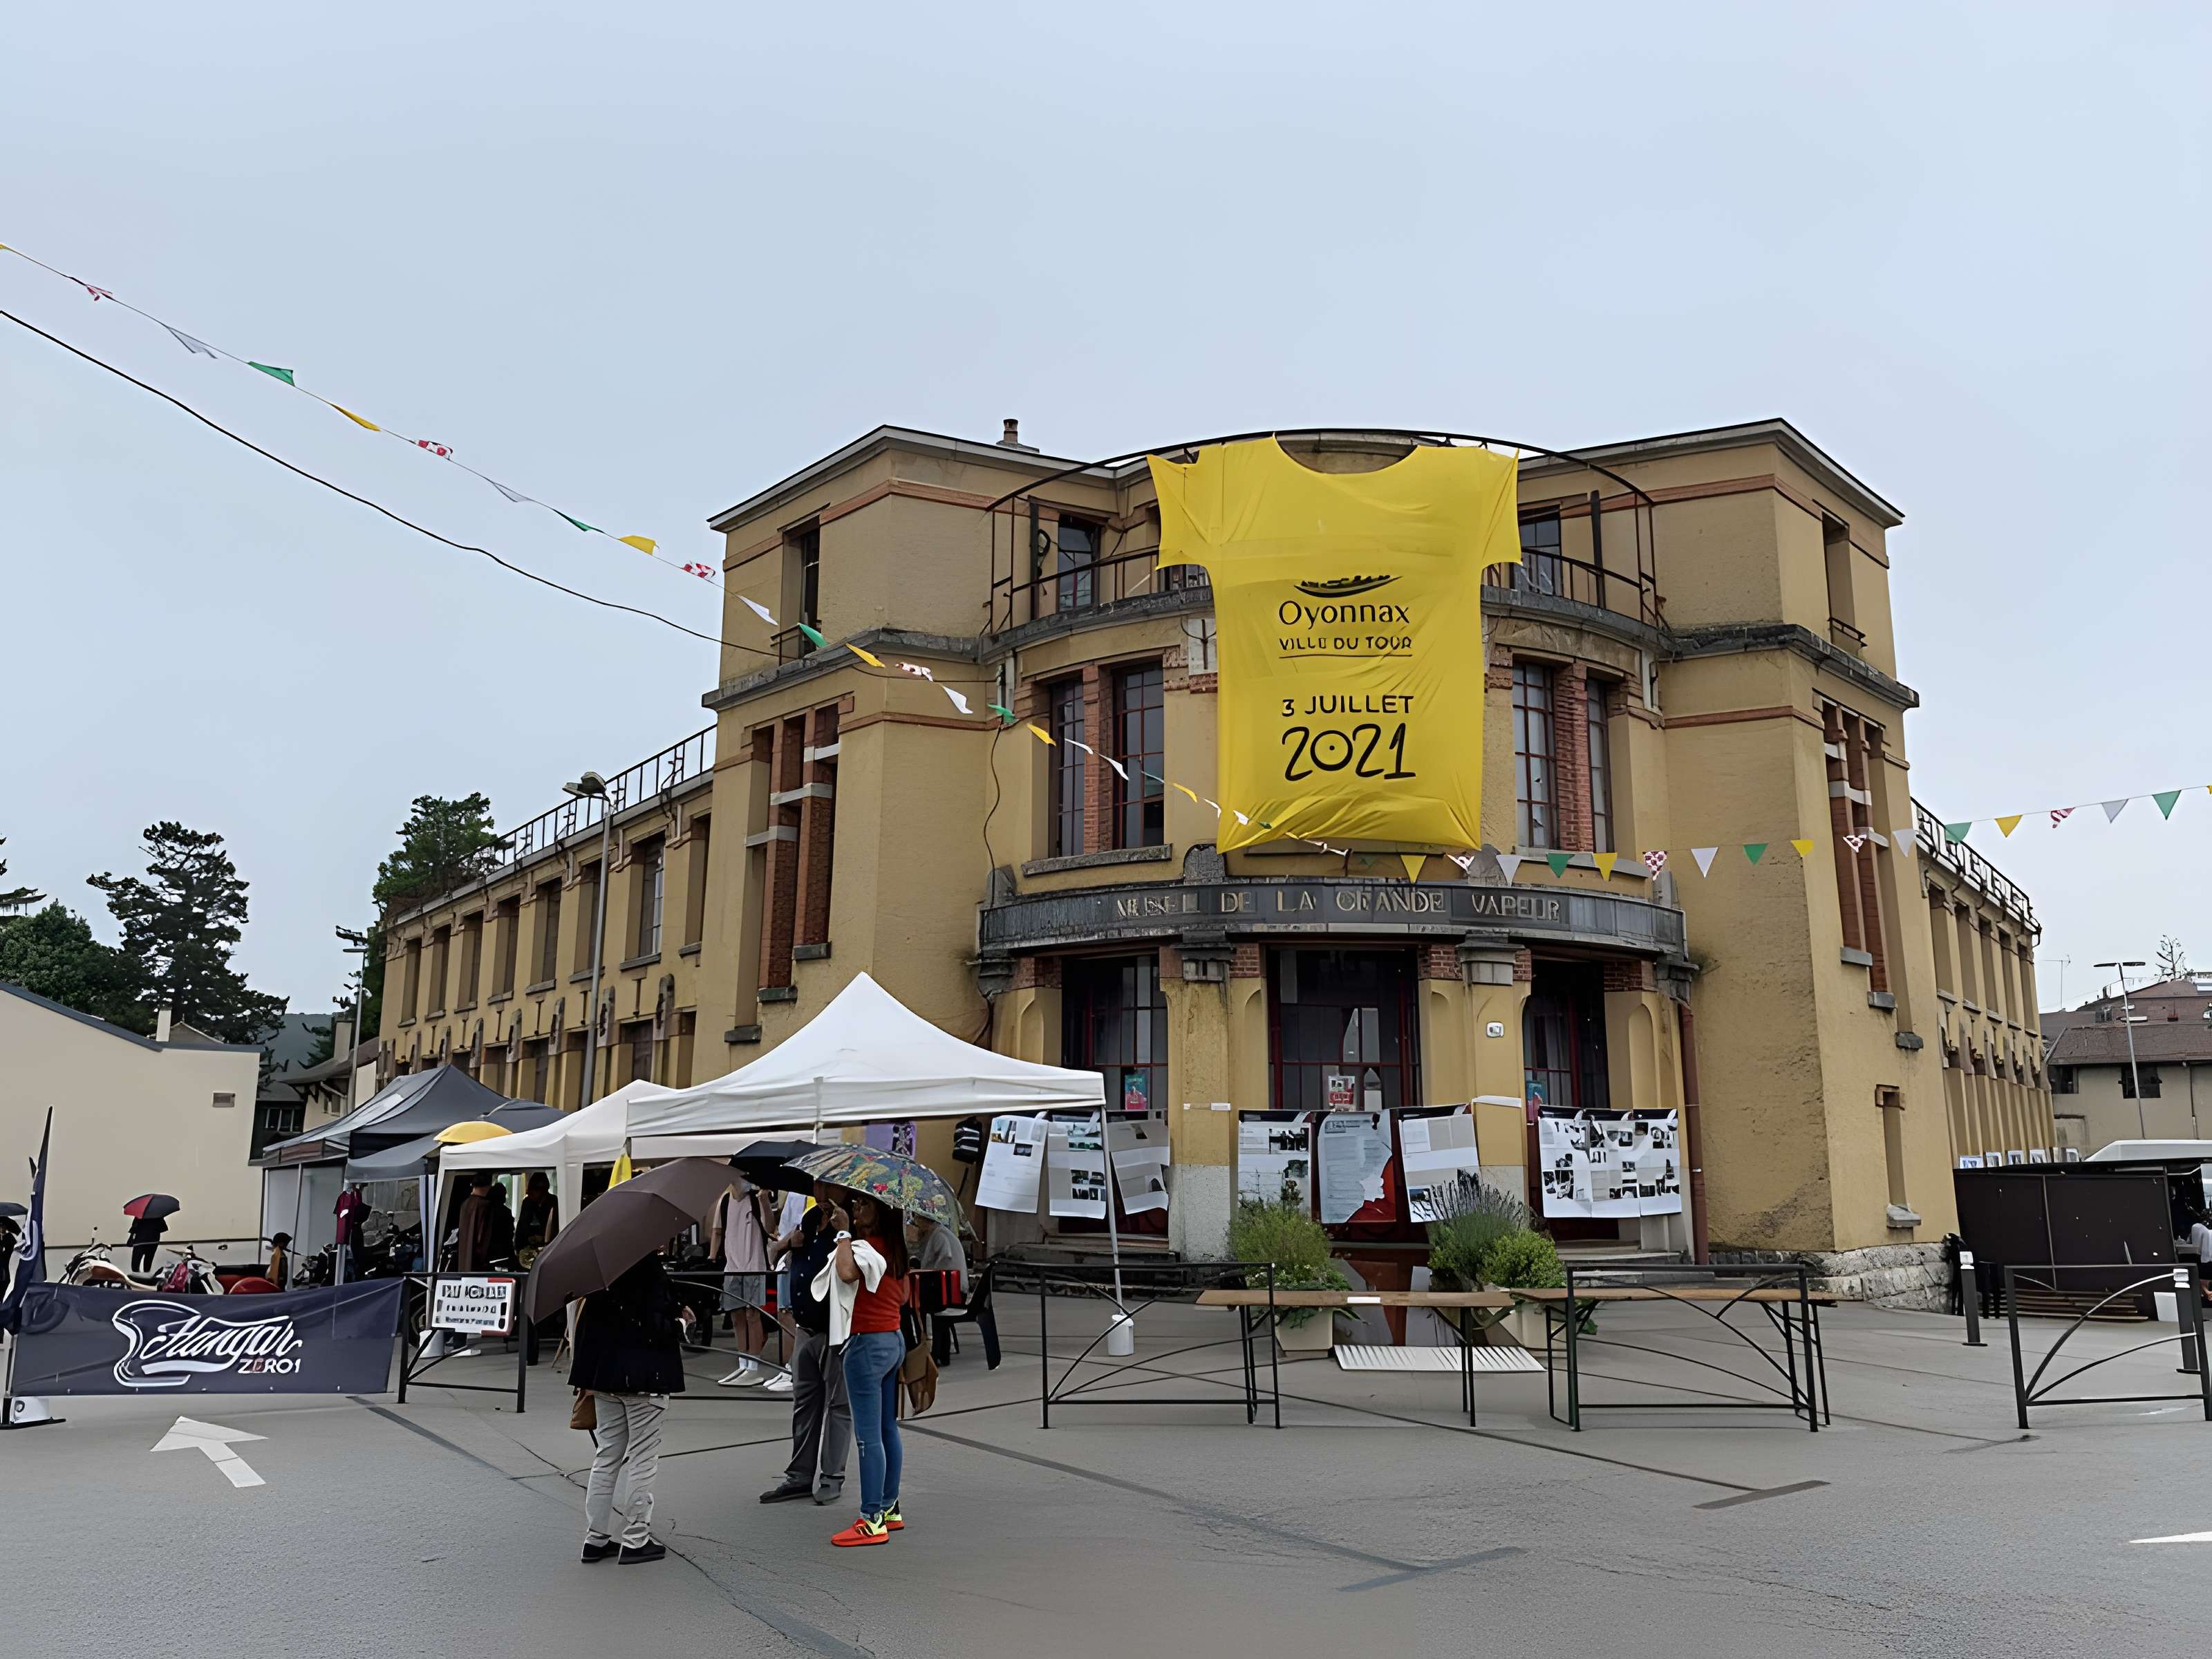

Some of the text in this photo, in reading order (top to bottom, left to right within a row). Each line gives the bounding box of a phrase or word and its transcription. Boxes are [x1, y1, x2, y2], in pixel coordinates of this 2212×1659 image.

[1279, 600, 1409, 630] Oyonnax
[1334, 637, 1358, 650] DU
[1282, 695, 1414, 717] 3 JUILLET
[1282, 722, 1416, 782] 2021
[1221, 891, 1257, 913] DE
[1277, 890, 1317, 912] LA
[140, 1315, 303, 1374] Hangar
